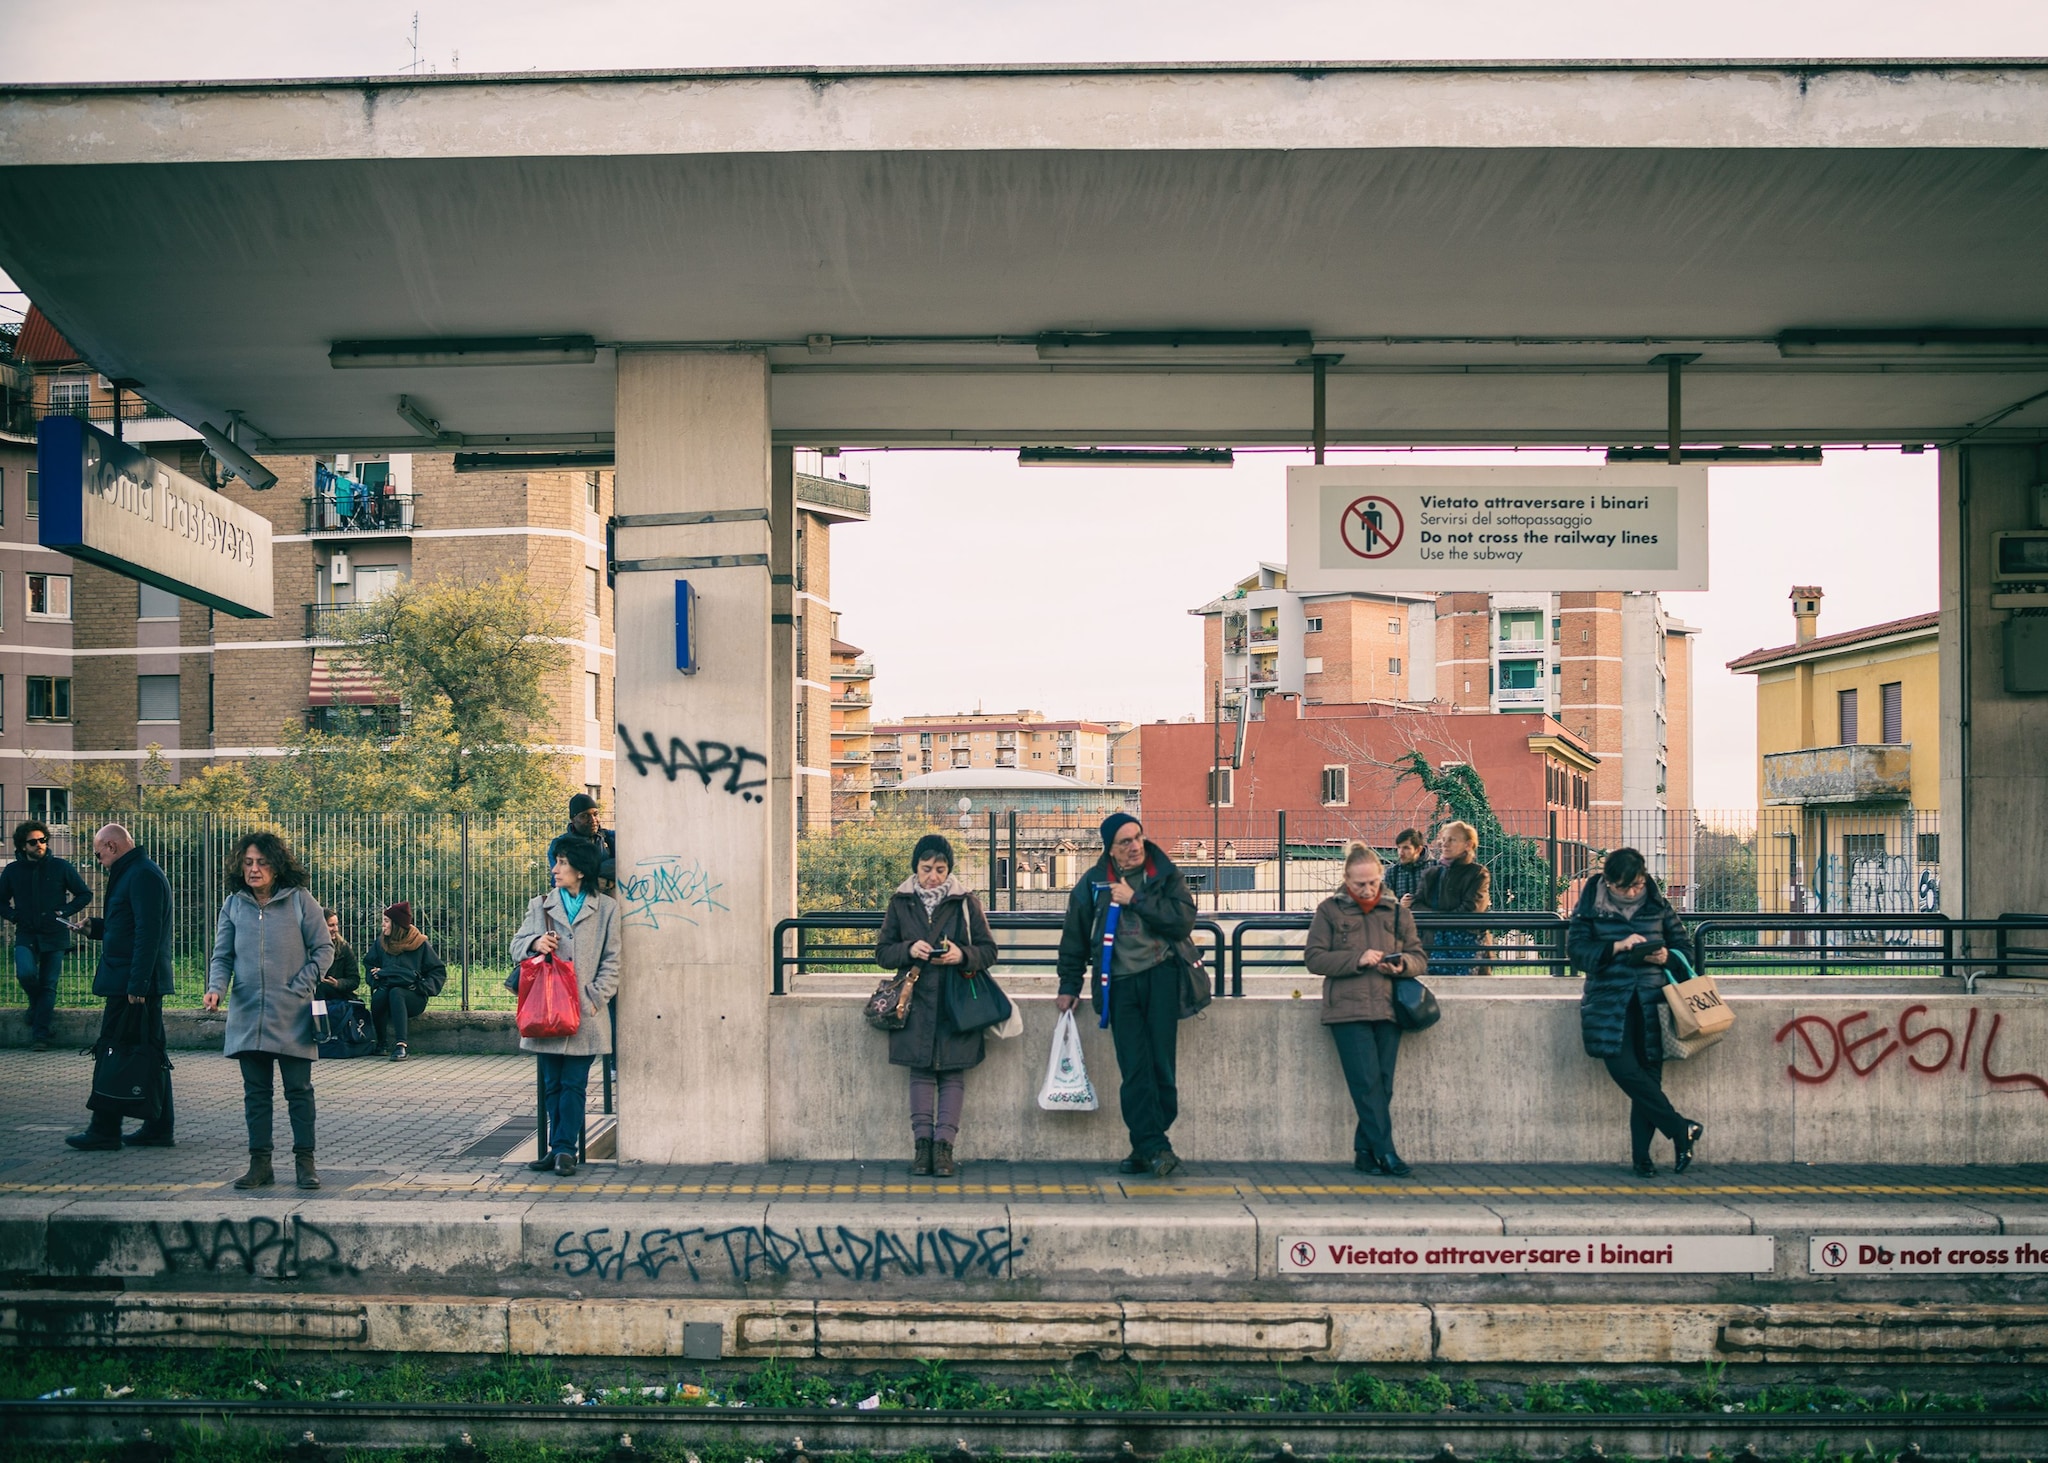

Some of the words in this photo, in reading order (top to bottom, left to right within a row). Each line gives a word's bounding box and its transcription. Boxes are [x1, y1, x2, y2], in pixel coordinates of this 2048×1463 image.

[87, 434, 154, 522] Roma
[157, 470, 255, 569] Trastevere
[1420, 495, 1479, 509] Vietato
[1484, 497, 1585, 510] attraversare
[1591, 495, 1595, 509] i
[1601, 495, 1649, 509] binari
[1420, 511, 1468, 525] Servirsi
[1472, 511, 1492, 525] del
[1496, 512, 1593, 529] sottopassaggio
[1421, 531, 1442, 543] Do
[1448, 532, 1474, 543] not
[1478, 533, 1518, 543] cross
[1524, 530, 1549, 543] the
[1554, 530, 1616, 547] railway
[1621, 530, 1658, 544] lines
[1420, 547, 1444, 560] Use
[1449, 546, 1469, 560] the
[1473, 546, 1523, 563] subway
[1328, 1244, 1418, 1264] Vietato
[1424, 1245, 1581, 1264] attraversare
[1587, 1243, 1593, 1264] i
[1600, 1243, 1673, 1264] binari
[1858, 1245, 1894, 1265] Do
[1900, 1247, 1942, 1265] not
[1947, 1249, 2009, 1265] cross
